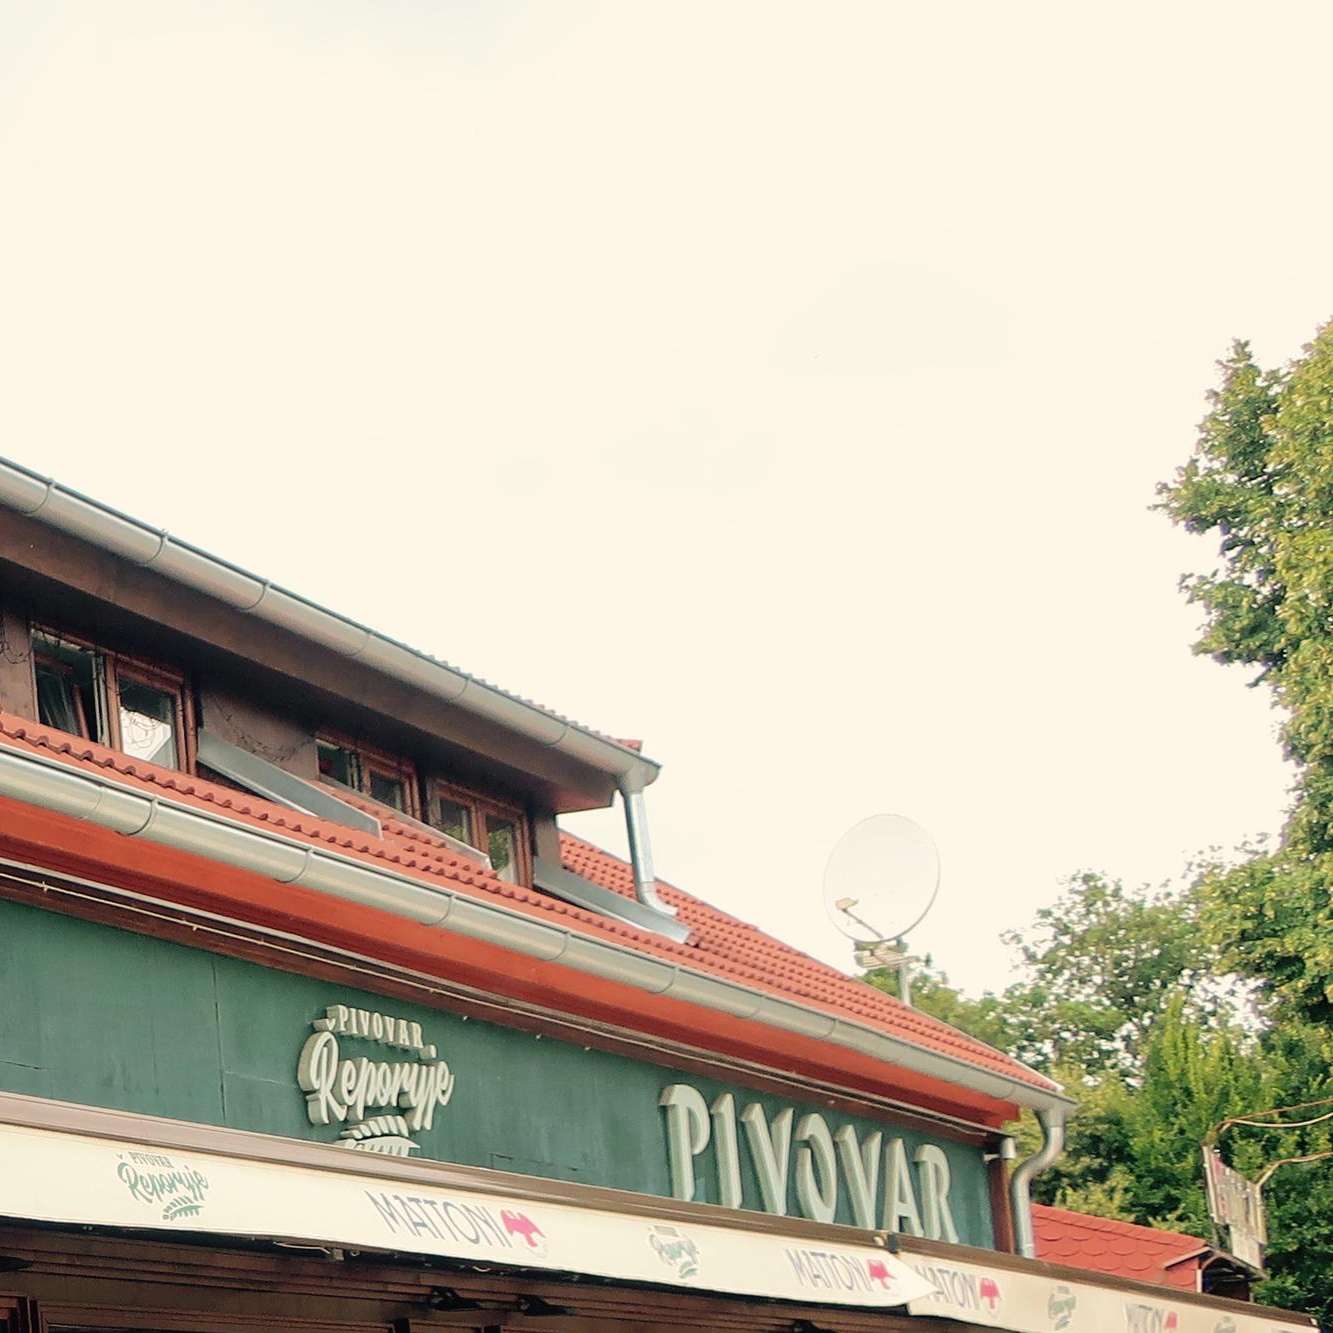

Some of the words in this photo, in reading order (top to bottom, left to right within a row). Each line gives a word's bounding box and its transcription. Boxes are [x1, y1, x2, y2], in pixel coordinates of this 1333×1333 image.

[326, 1004, 424, 1049] PIVOVAR
[659, 1083, 960, 1244] PIVOVAR
[363, 1189, 514, 1249] MATTONI
[785, 1247, 874, 1293] MATTONI
